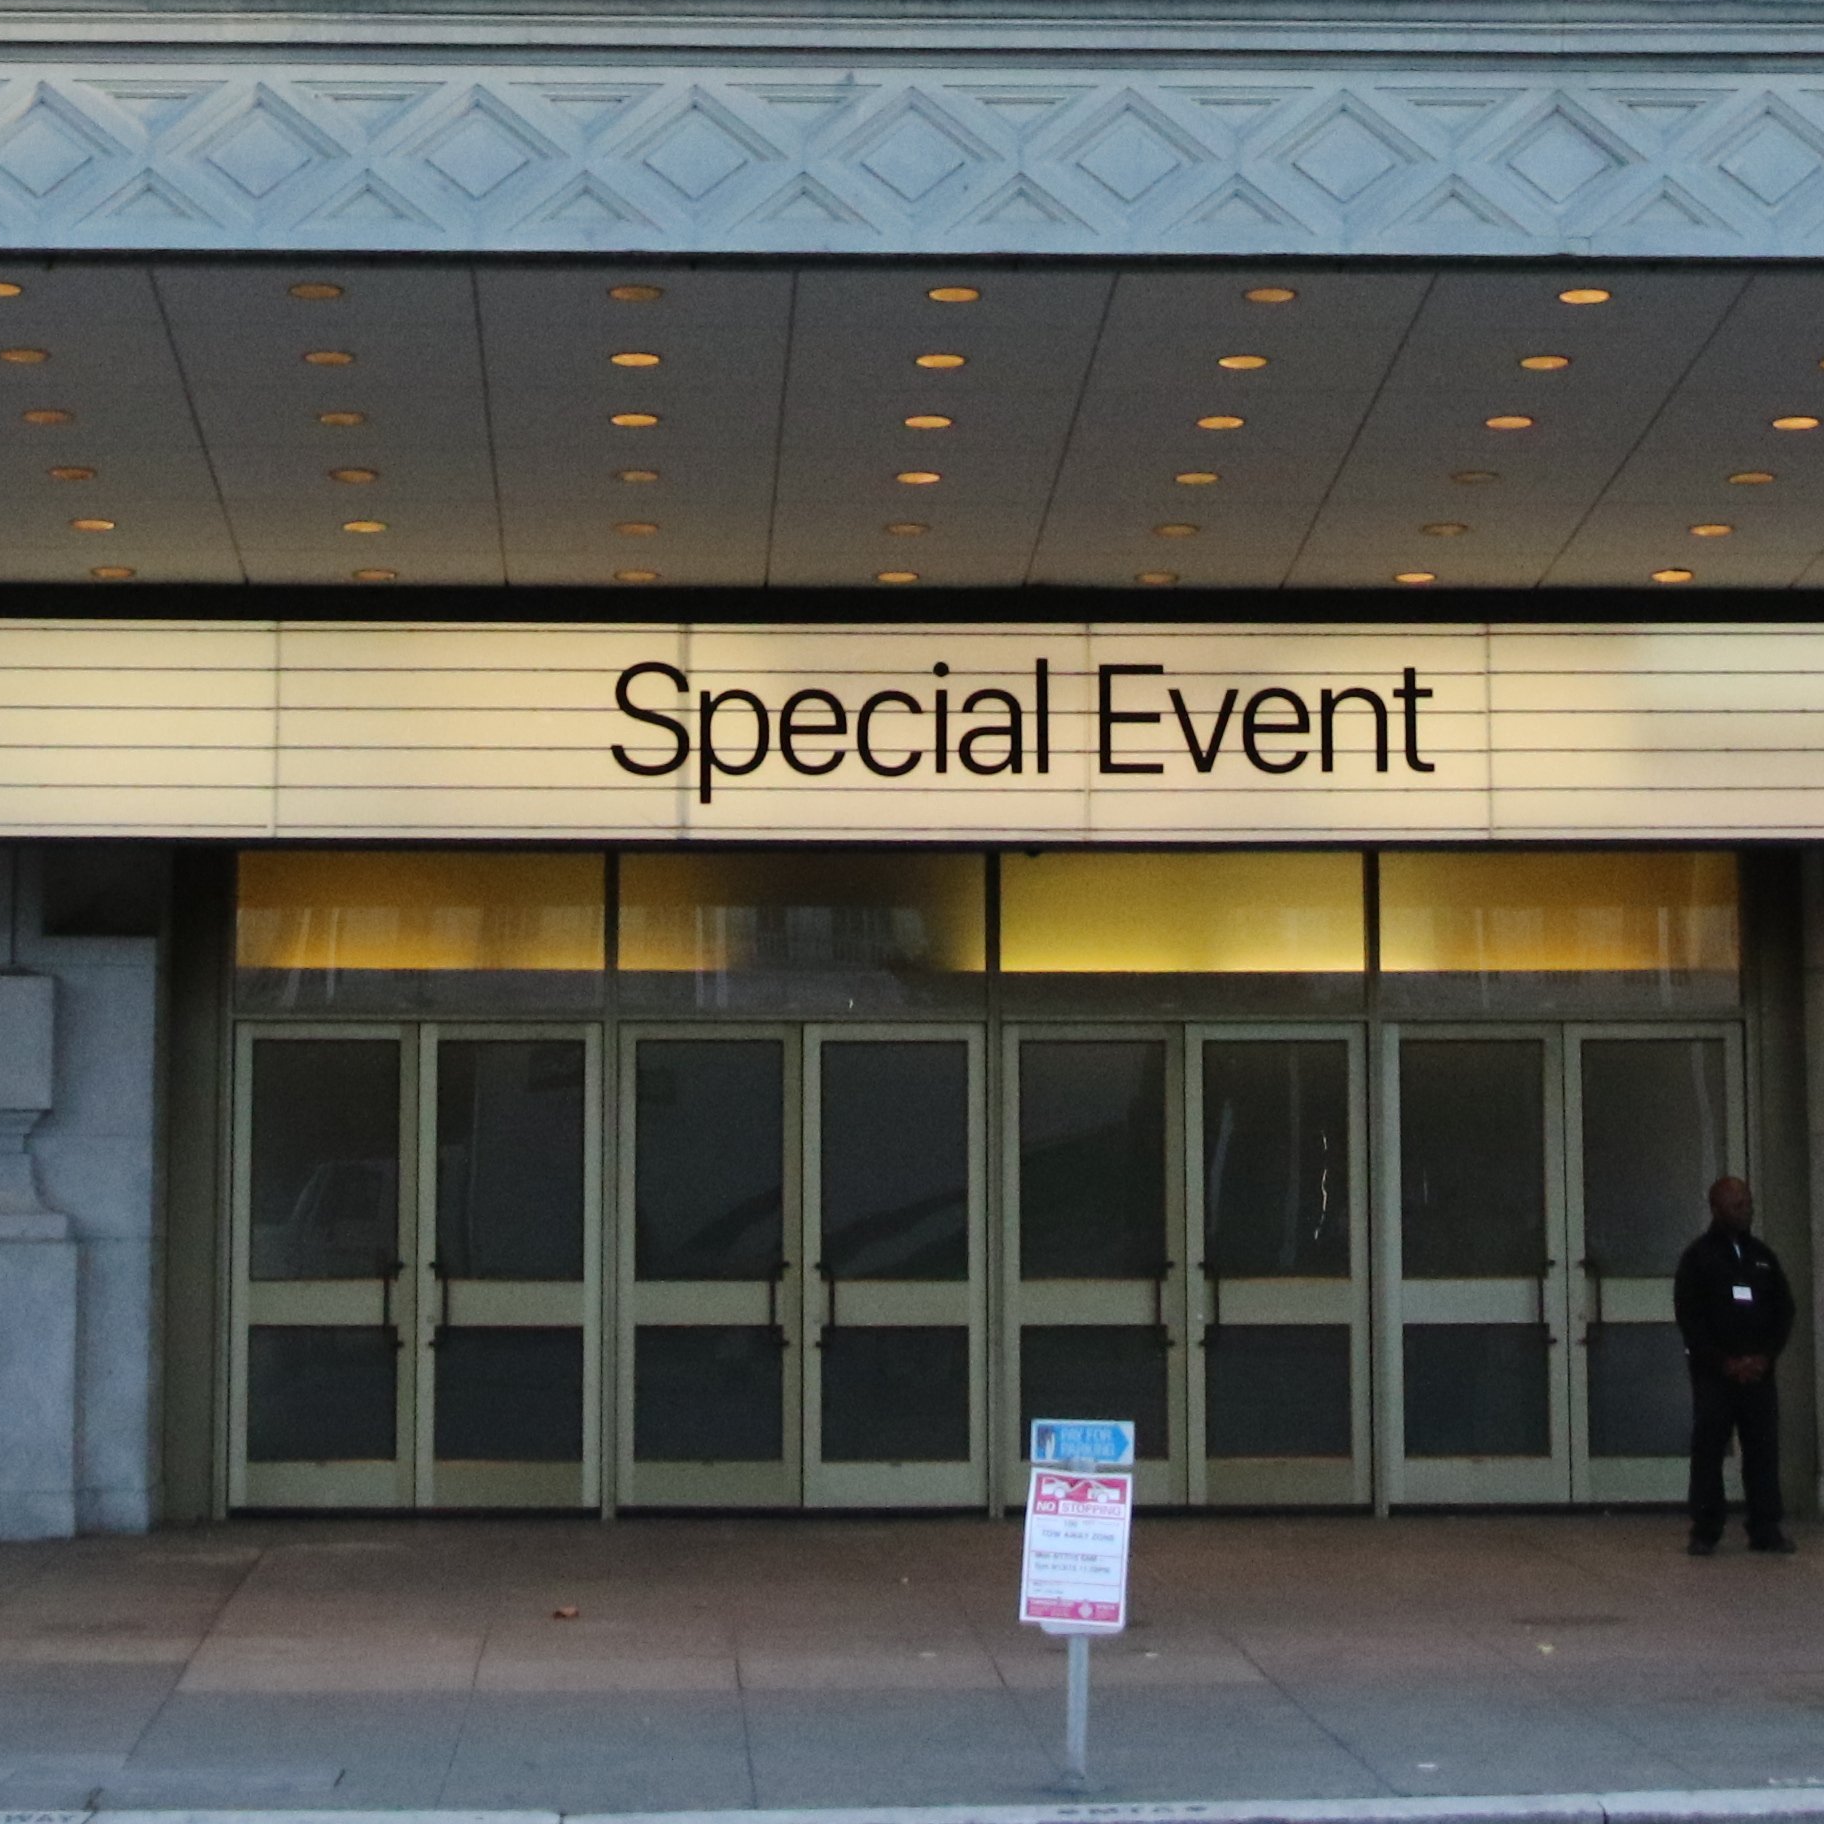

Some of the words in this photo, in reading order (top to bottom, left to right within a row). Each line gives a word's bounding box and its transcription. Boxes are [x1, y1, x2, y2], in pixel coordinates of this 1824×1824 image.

[611, 658, 1049, 803] Special
[1098, 663, 1435, 775] Event
[1036, 1500, 1056, 1512] NO
[1061, 1502, 1121, 1517] STOPPING
[1042, 1529, 1061, 1538] TOW
[1064, 1531, 1089, 1540] AWAY
[1091, 1532, 1115, 1542] ZONE
